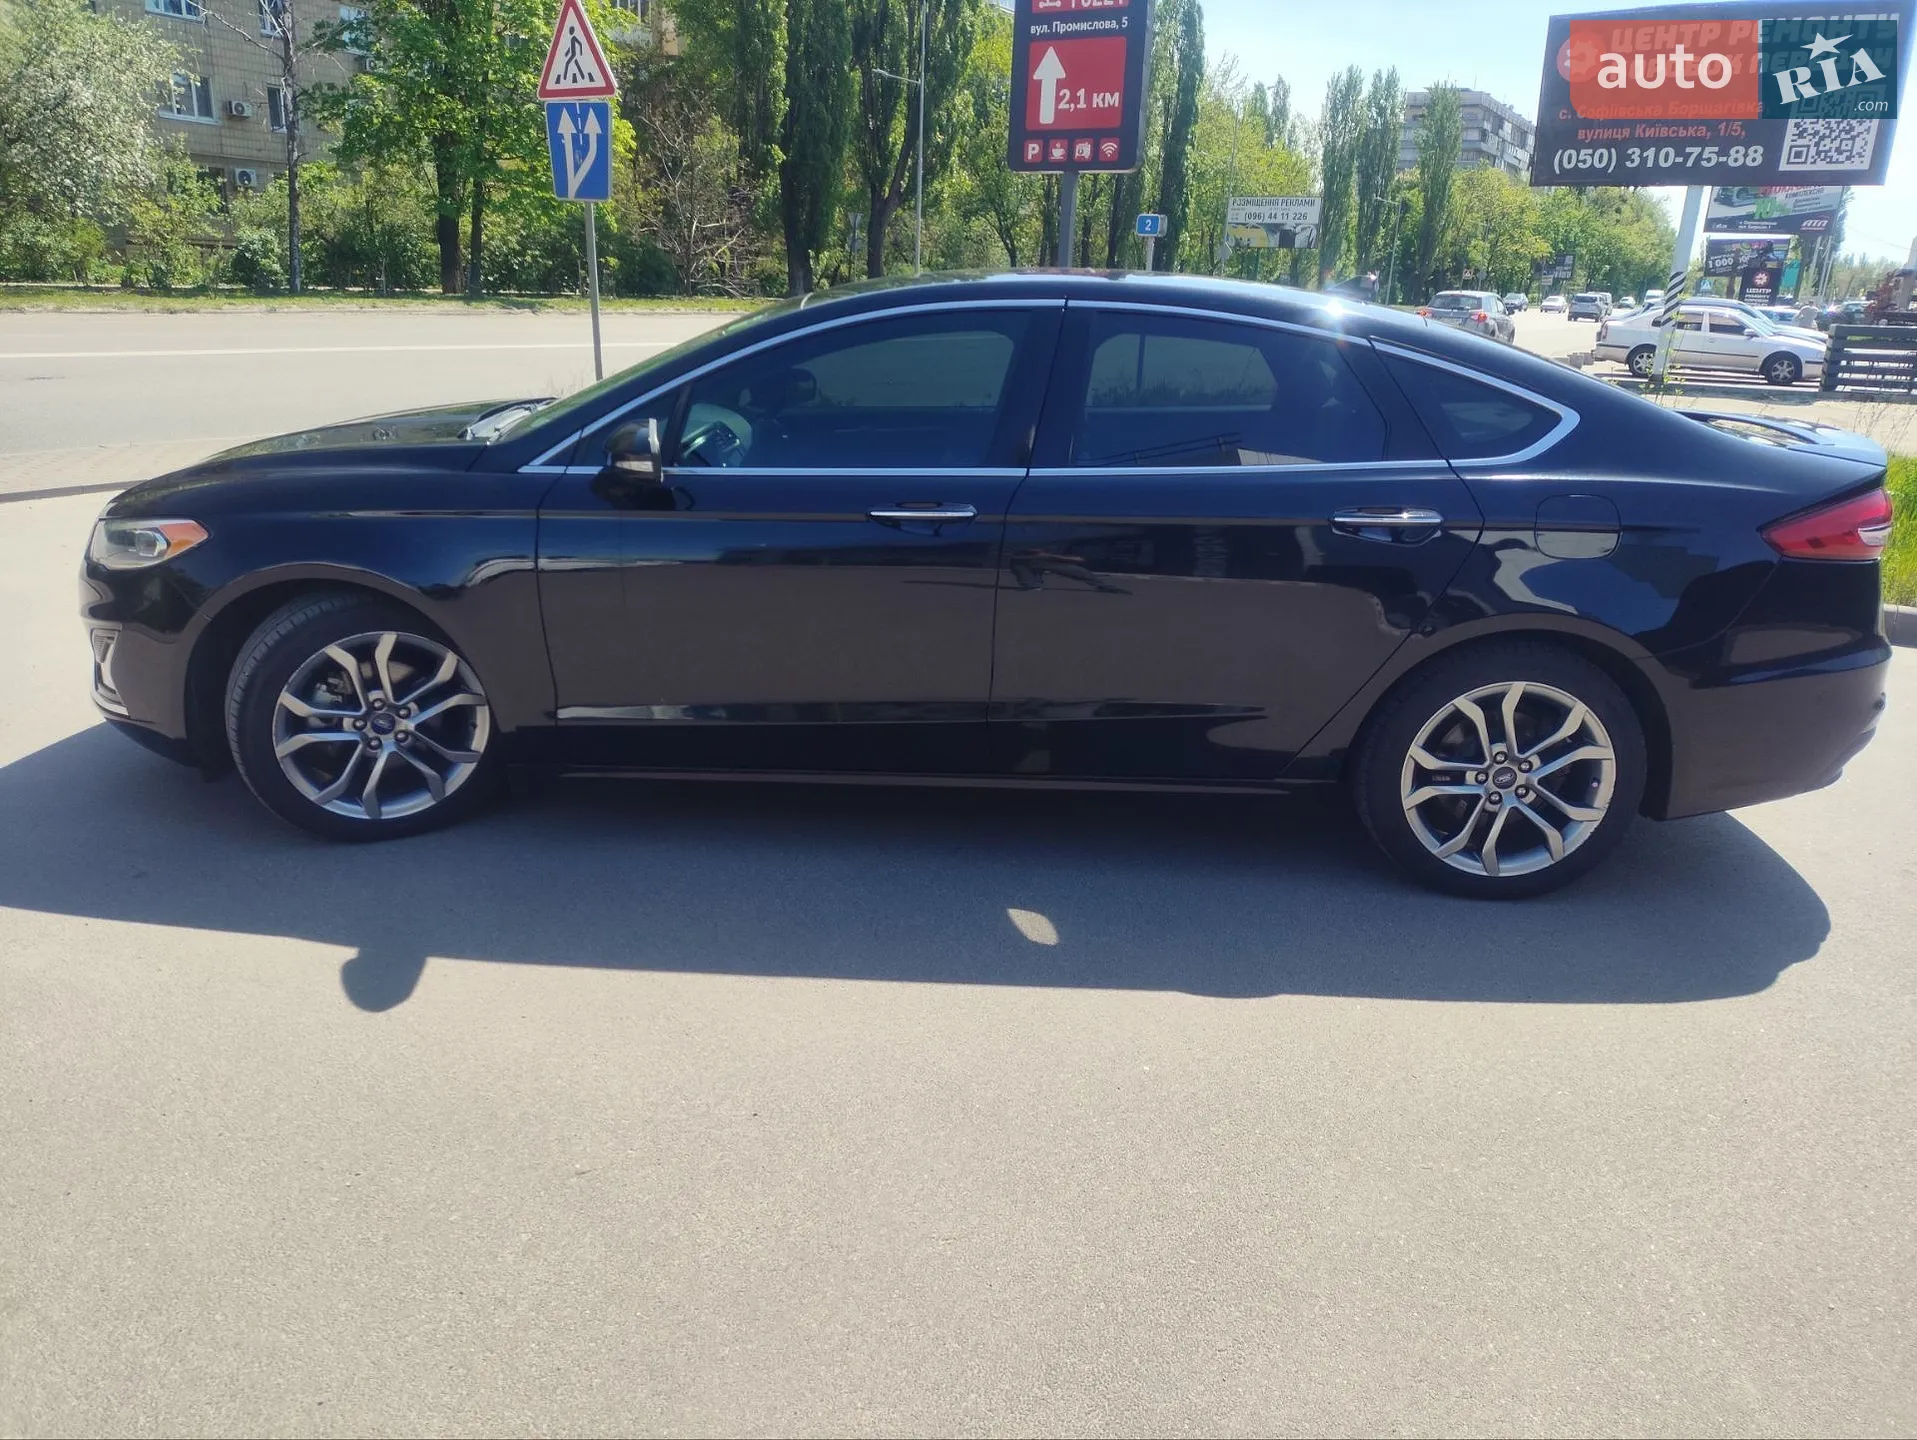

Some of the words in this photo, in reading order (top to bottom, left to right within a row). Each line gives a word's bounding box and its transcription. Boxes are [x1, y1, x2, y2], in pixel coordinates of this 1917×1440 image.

[1030, 24, 1050, 36] вул.
[1052, 19, 1119, 34] Промислова,
[1121, 16, 1128, 28] 5
[1058, 88, 1086, 112] 2,1
[1577, 127, 1630, 143] вулиця
[1635, 123, 1711, 140] Київська,
[1718, 121, 1746, 139] 1/5,
[1553, 147, 1617, 174] (050)
[1625, 145, 1764, 168] 310-75-88
[1280, 198, 1315, 207] РЕКЛАМИ
[1144, 219, 1152, 231] 2
[1244, 212, 1265, 221] (096)
[1268, 212, 1277, 220] 44
[1281, 212, 1289, 220] 11
[1293, 212, 1308, 220] 226
